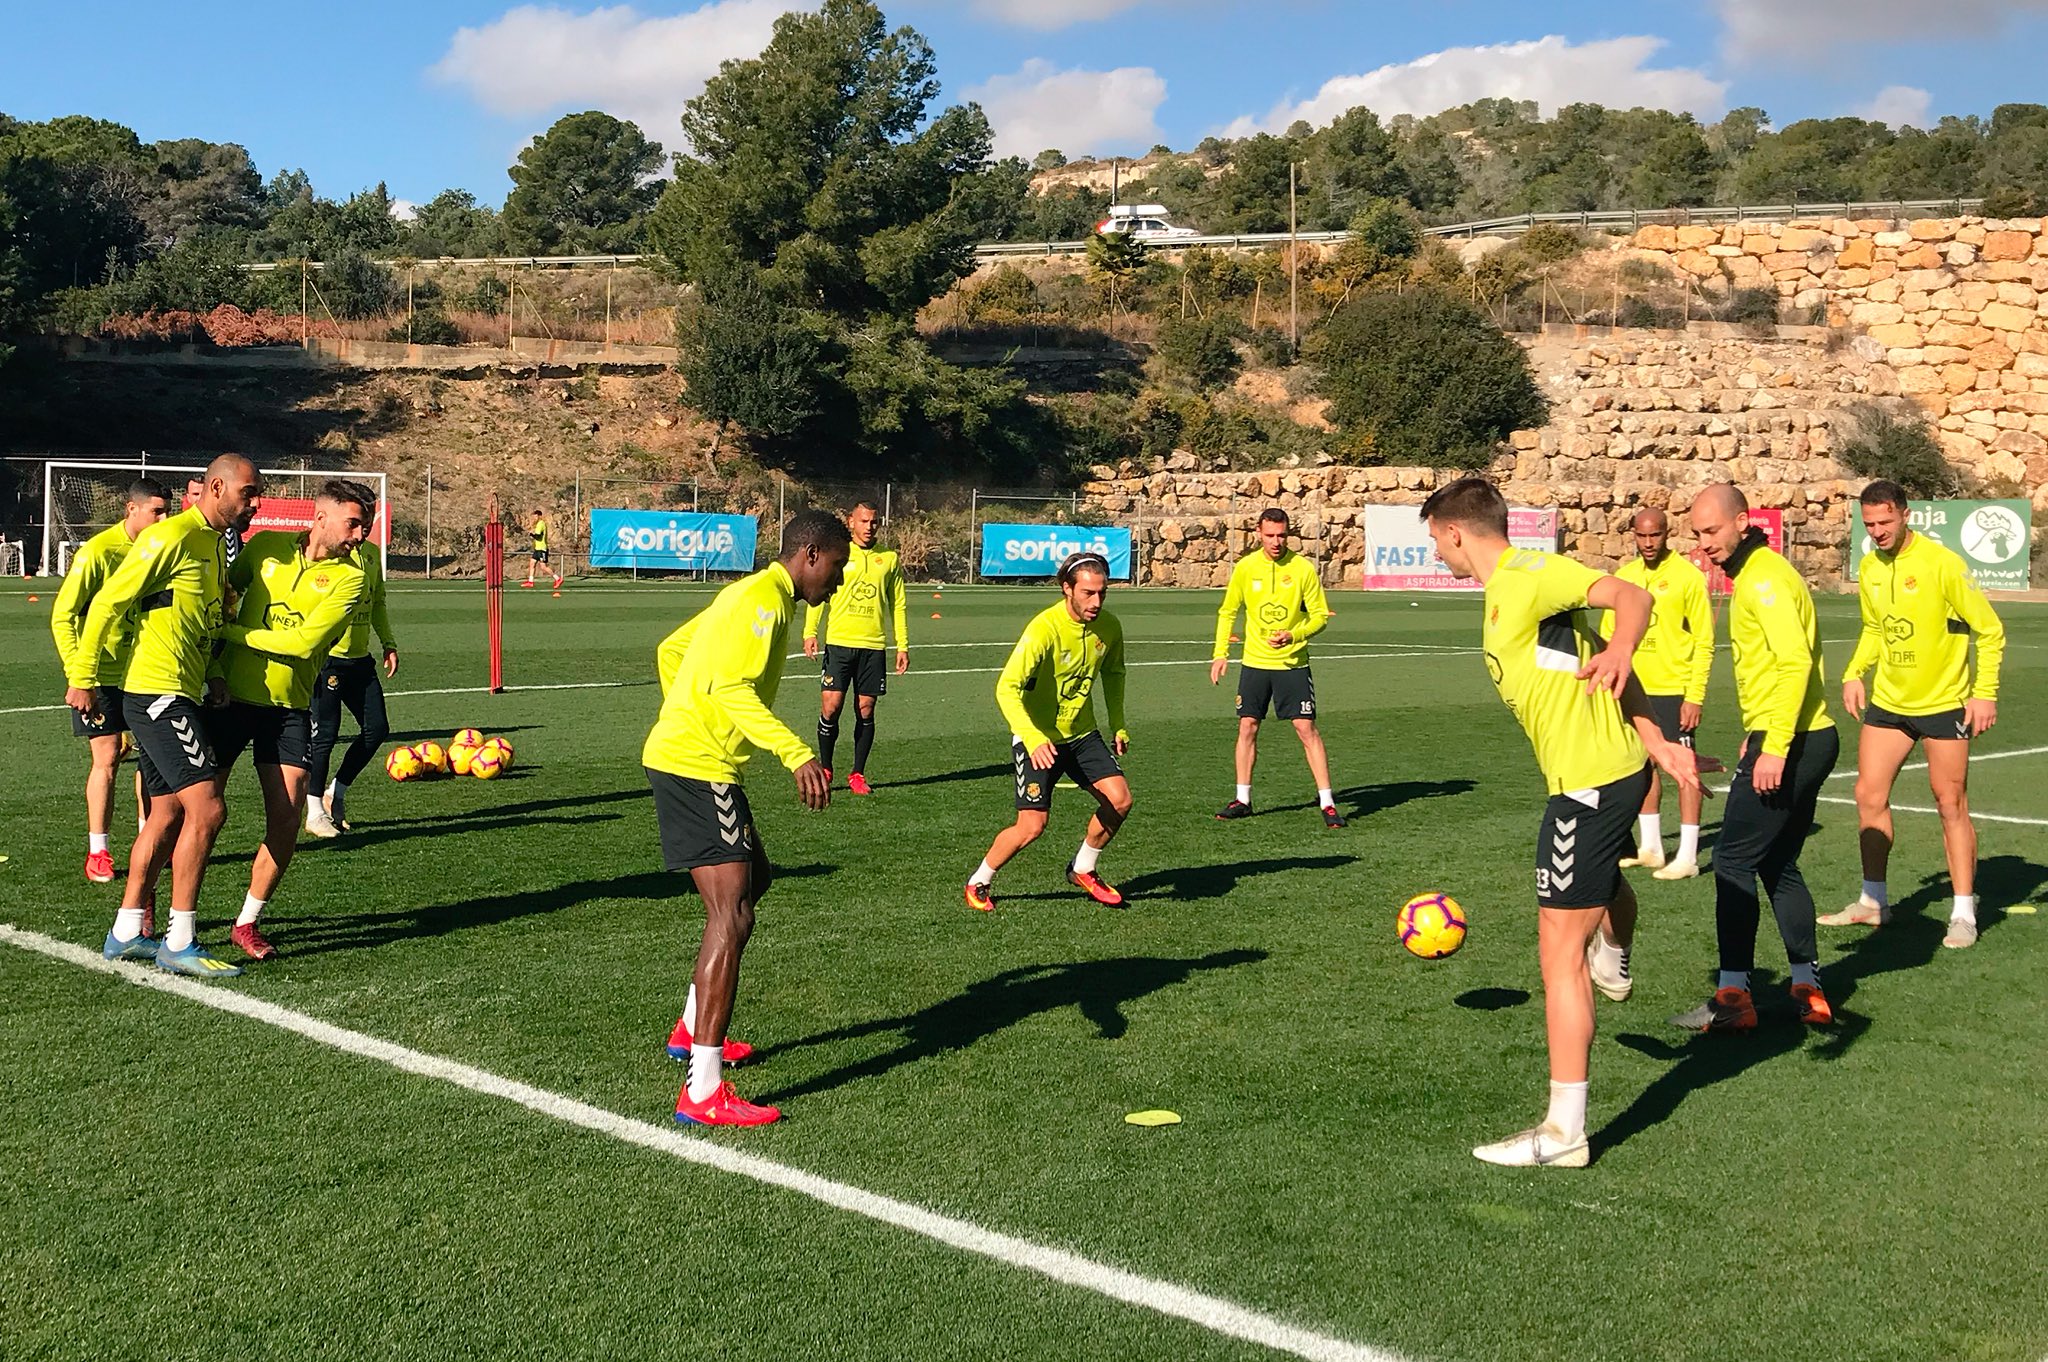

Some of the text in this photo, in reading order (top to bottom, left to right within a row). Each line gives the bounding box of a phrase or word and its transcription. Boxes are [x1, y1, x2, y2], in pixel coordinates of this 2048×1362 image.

[1375, 546, 1428, 566] FAST
[272, 613, 298, 629] INEX
[1300, 700, 1312, 712] 16
